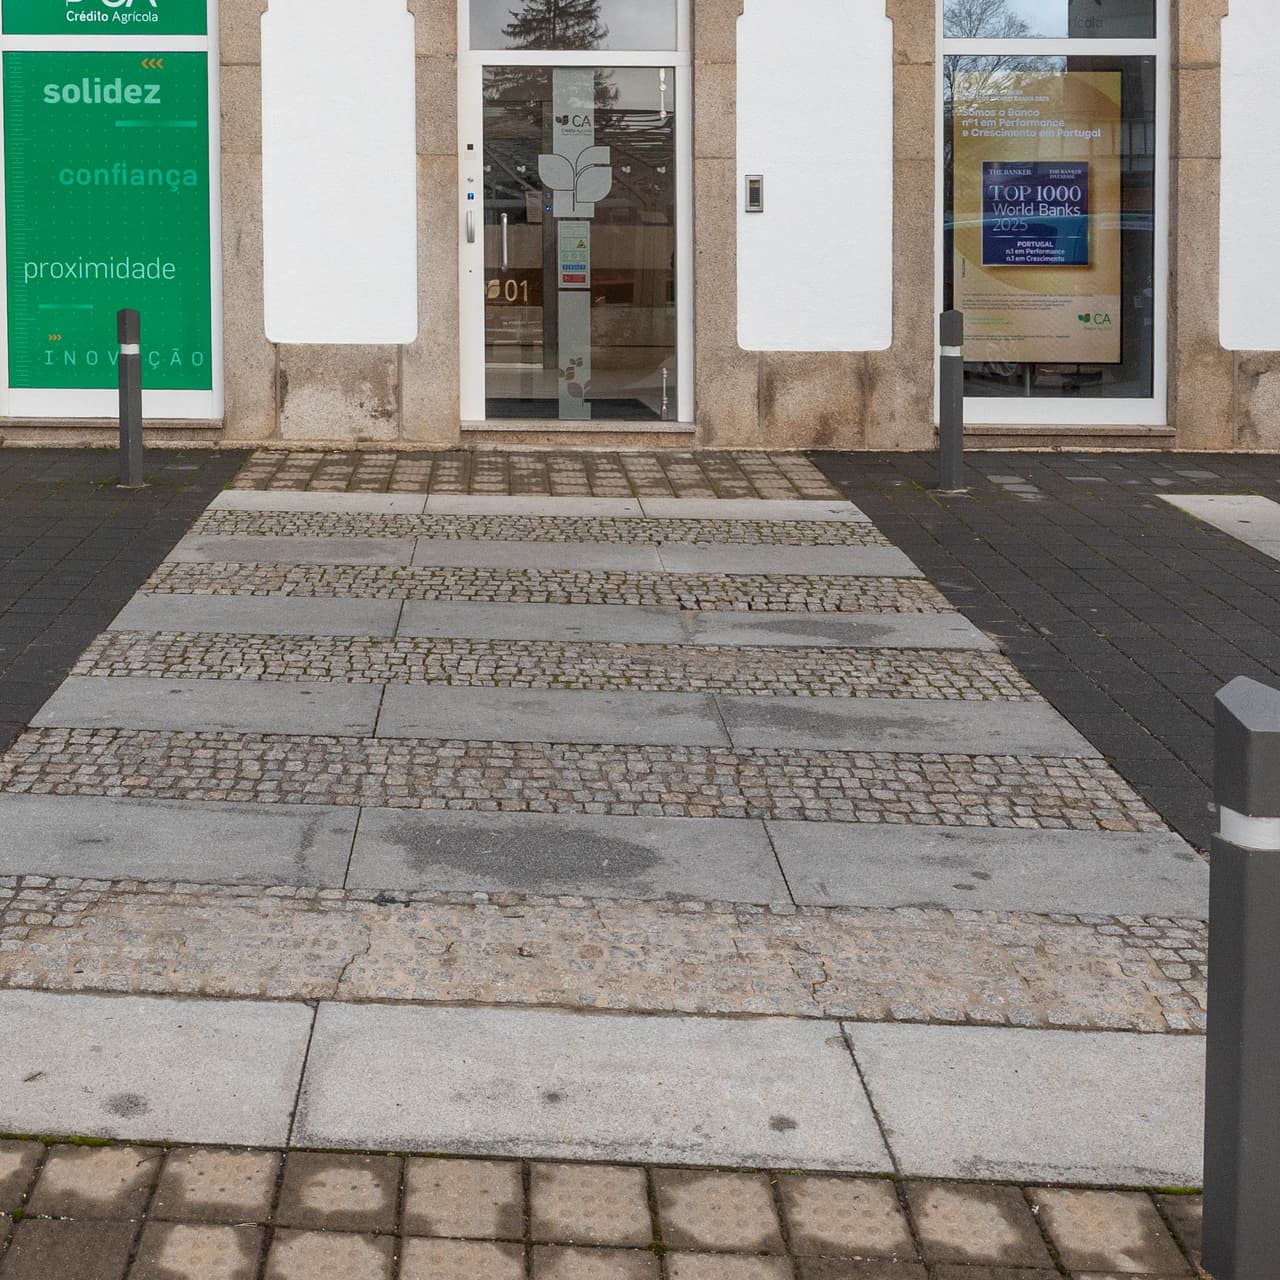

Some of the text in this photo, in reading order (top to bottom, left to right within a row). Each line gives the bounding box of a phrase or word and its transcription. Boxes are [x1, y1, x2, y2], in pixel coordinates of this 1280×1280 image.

[66, 10, 158, 24] Crédito Agrícola
[43, 78, 161, 104] solidez
[962, 108, 996, 117] Somos
[1008, 108, 1040, 117] Banco
[572, 114, 592, 128] CA
[999, 119, 1065, 127] Performance
[971, 128, 1037, 137] Crescimento
[1057, 128, 1101, 140] Portugal
[59, 162, 198, 192] confiança
[989, 185, 1081, 202] TOP 1000
[992, 202, 1081, 216] World Banks
[991, 218, 1029, 231] 2025
[23, 256, 176, 284] proximidade
[504, 279, 529, 302] 01
[1093, 313, 1112, 325] CA
[44, 348, 204, 369] INOVÇÃO
